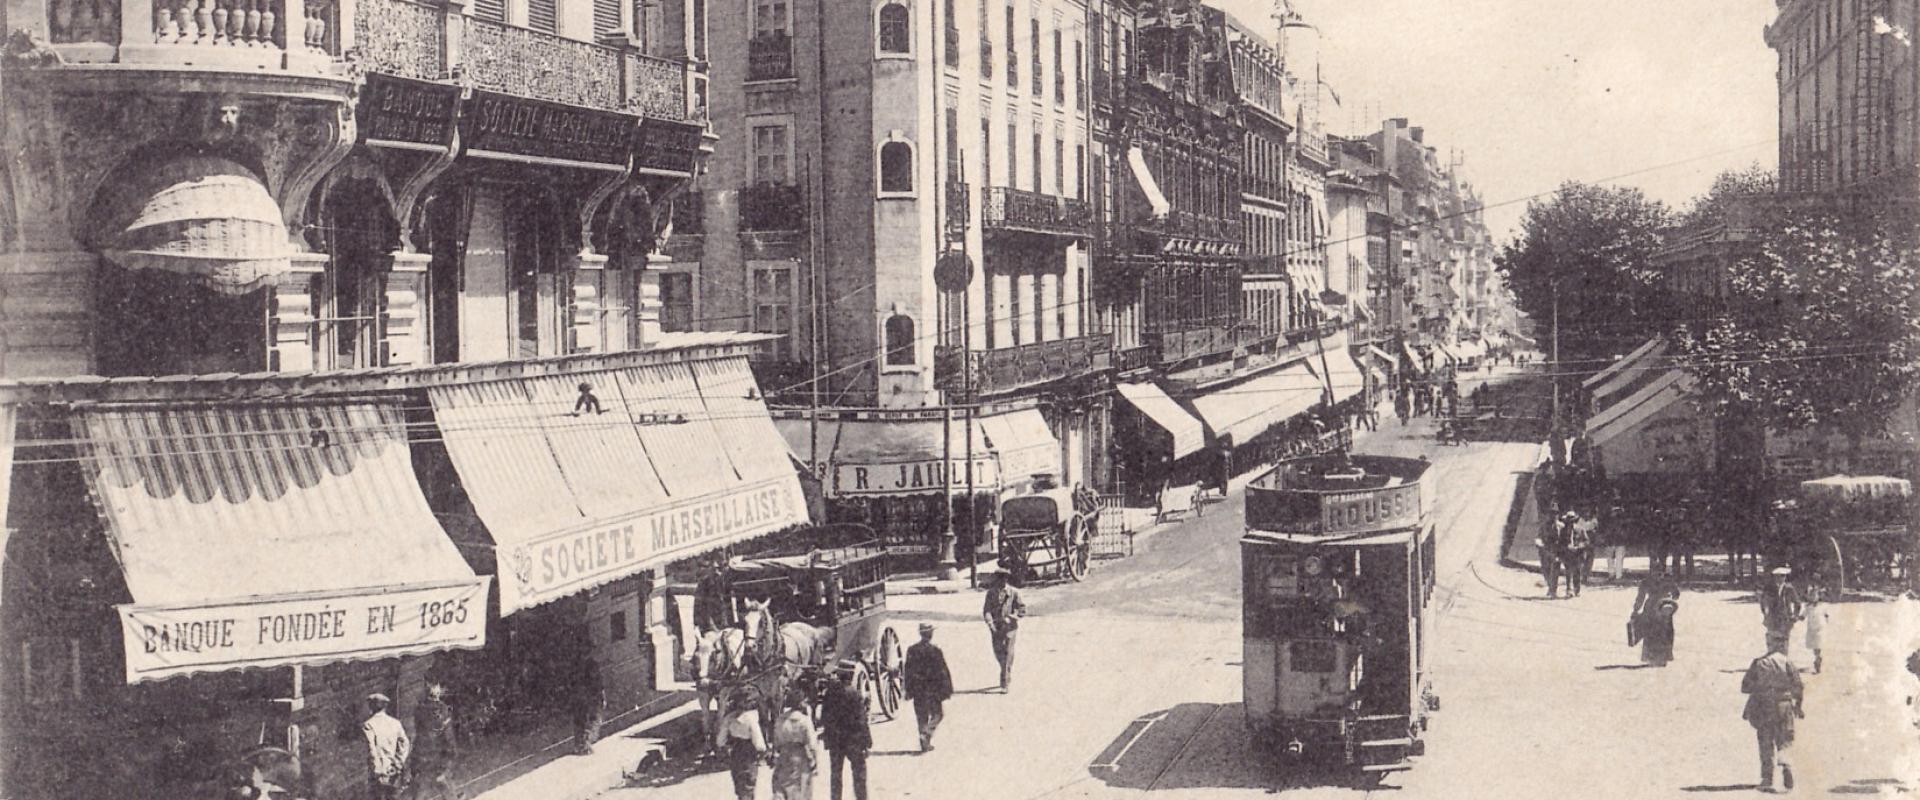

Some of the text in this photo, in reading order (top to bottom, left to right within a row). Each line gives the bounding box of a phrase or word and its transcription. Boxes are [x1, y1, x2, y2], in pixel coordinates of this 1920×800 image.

[382, 84, 447, 118] BANQUE
[895, 461, 985, 489] JAILLT
[540, 489, 781, 585] SOCIETE MARSEILLAISE
[143, 597, 470, 654] BANQUE FONDÉE EN 1865
